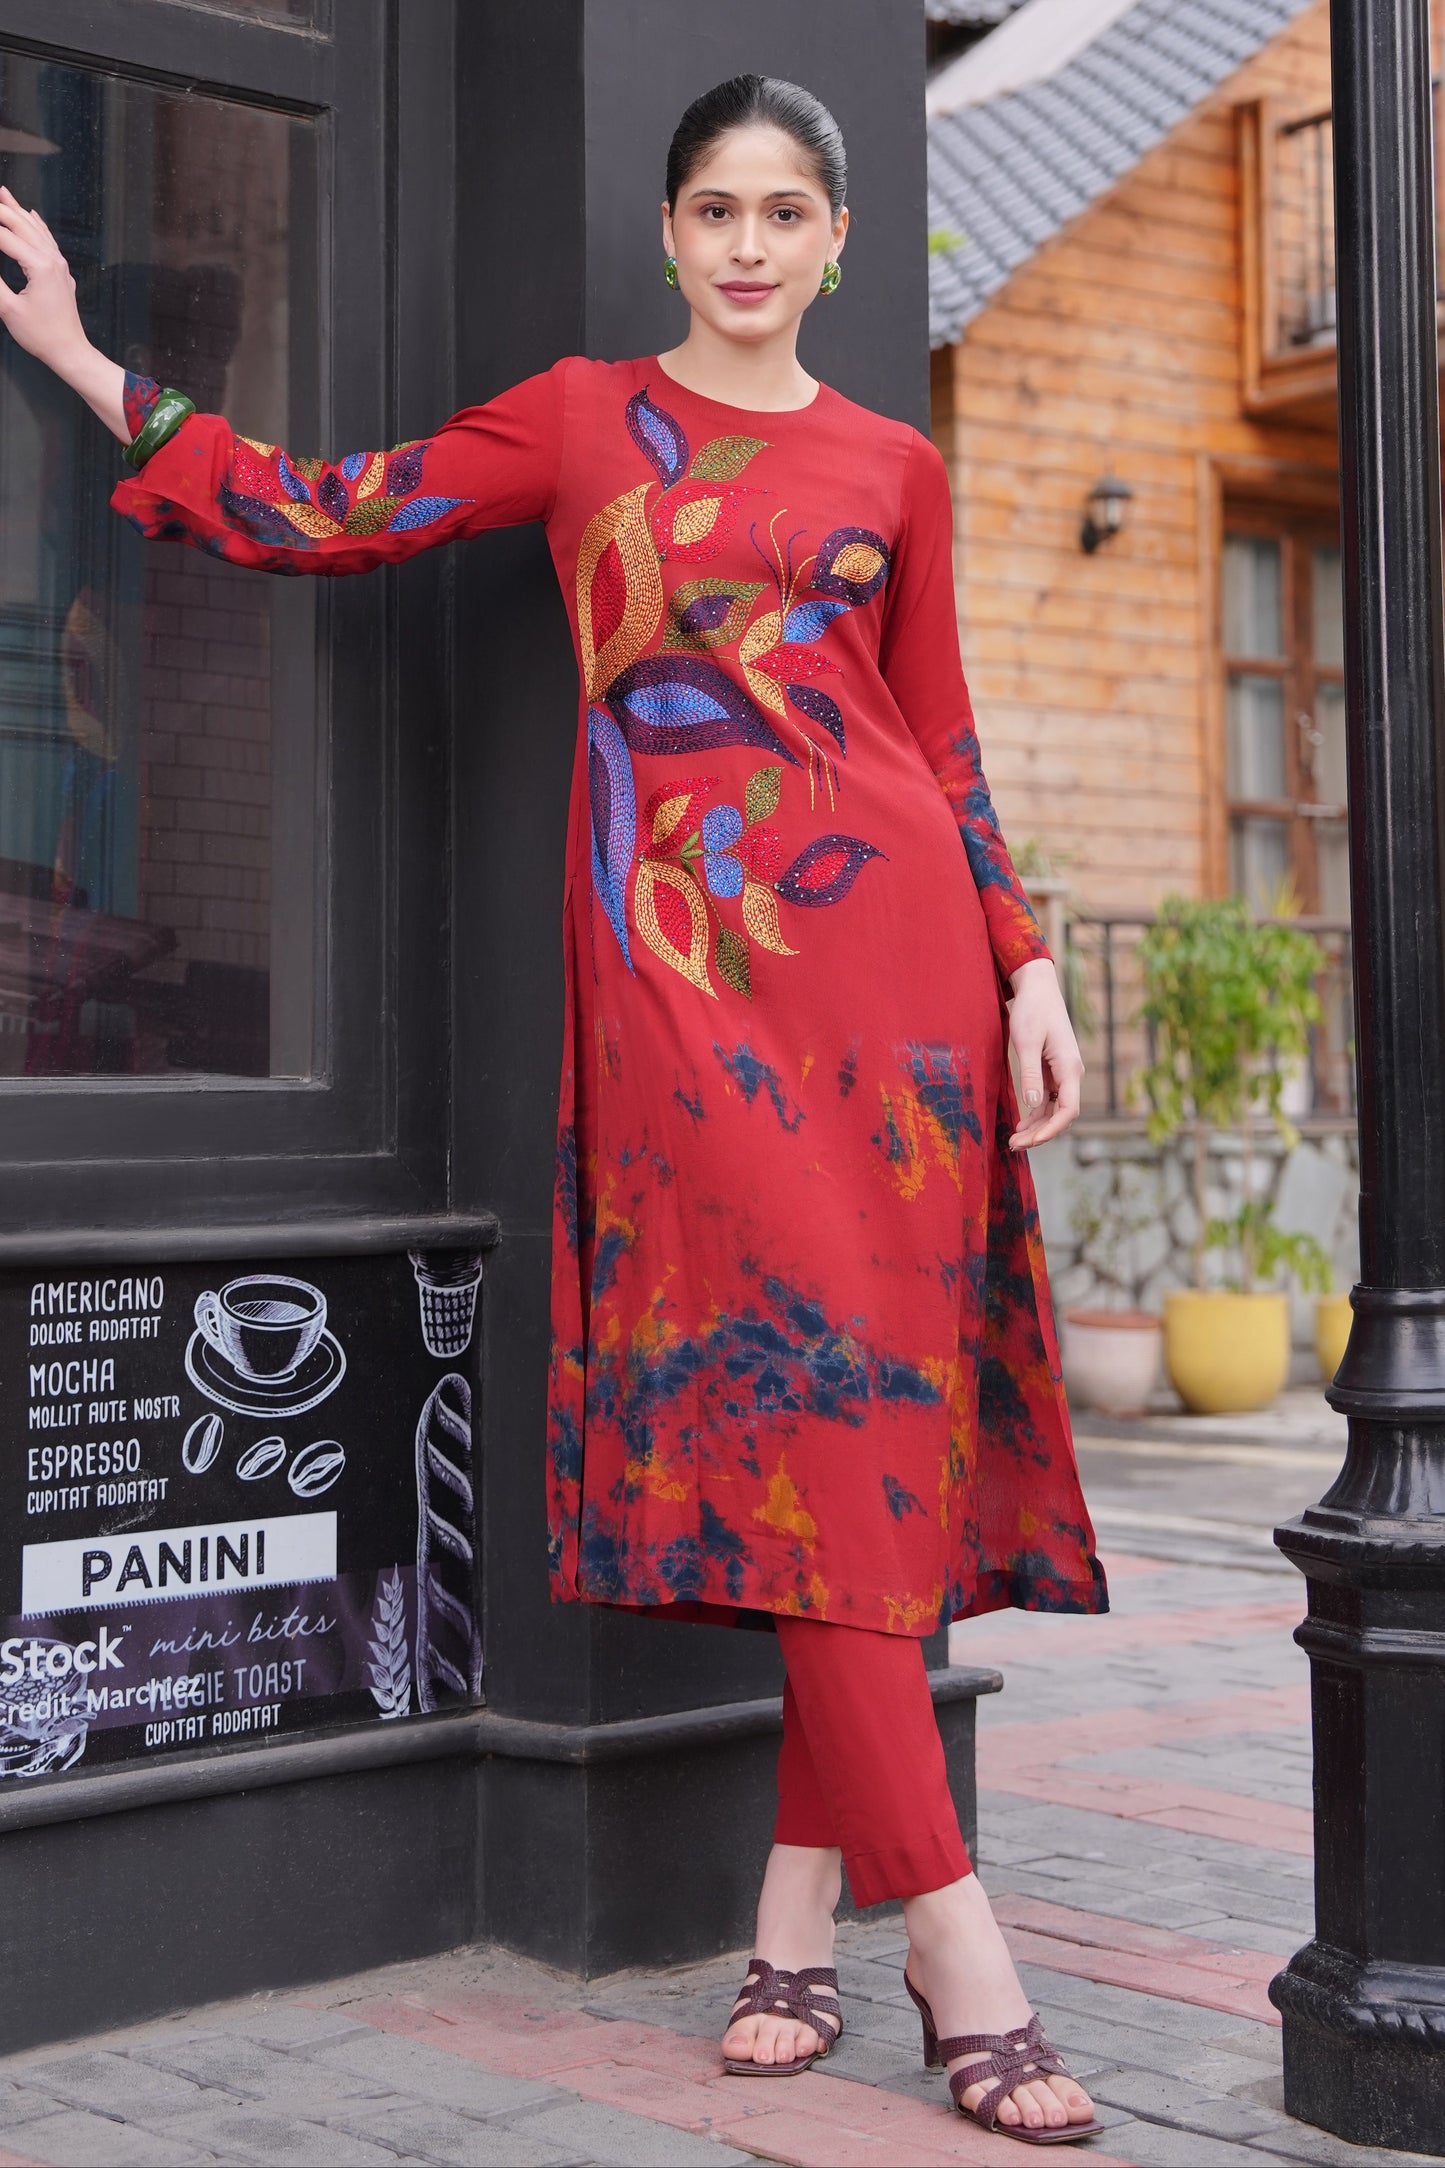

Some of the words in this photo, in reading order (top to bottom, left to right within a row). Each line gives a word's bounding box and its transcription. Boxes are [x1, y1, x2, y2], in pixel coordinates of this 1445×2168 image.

[30, 1276, 164, 1316] AMERICANO
[30, 1321, 82, 1346] DOLORE
[89, 1316, 161, 1342] ADDATAT
[29, 1358, 115, 1398] MOCHA
[29, 1403, 82, 1430] MOLLIT
[88, 1400, 127, 1424] AUTE
[134, 1395, 181, 1421] NOSTR
[27, 1438, 141, 1481] ESPRESSO
[27, 1485, 91, 1515] CUPITAT
[97, 1478, 169, 1507] ADDATAT
[82, 1530, 265, 1597] PANINI
[149, 1620, 241, 1657] mini
[246, 1605, 337, 1643] bites
[87, 1676, 200, 1713] Marchiez
[234, 1659, 307, 1700] TOAST
[145, 1715, 207, 1747] CUPITAT
[212, 1703, 282, 1736] ADDATAT
